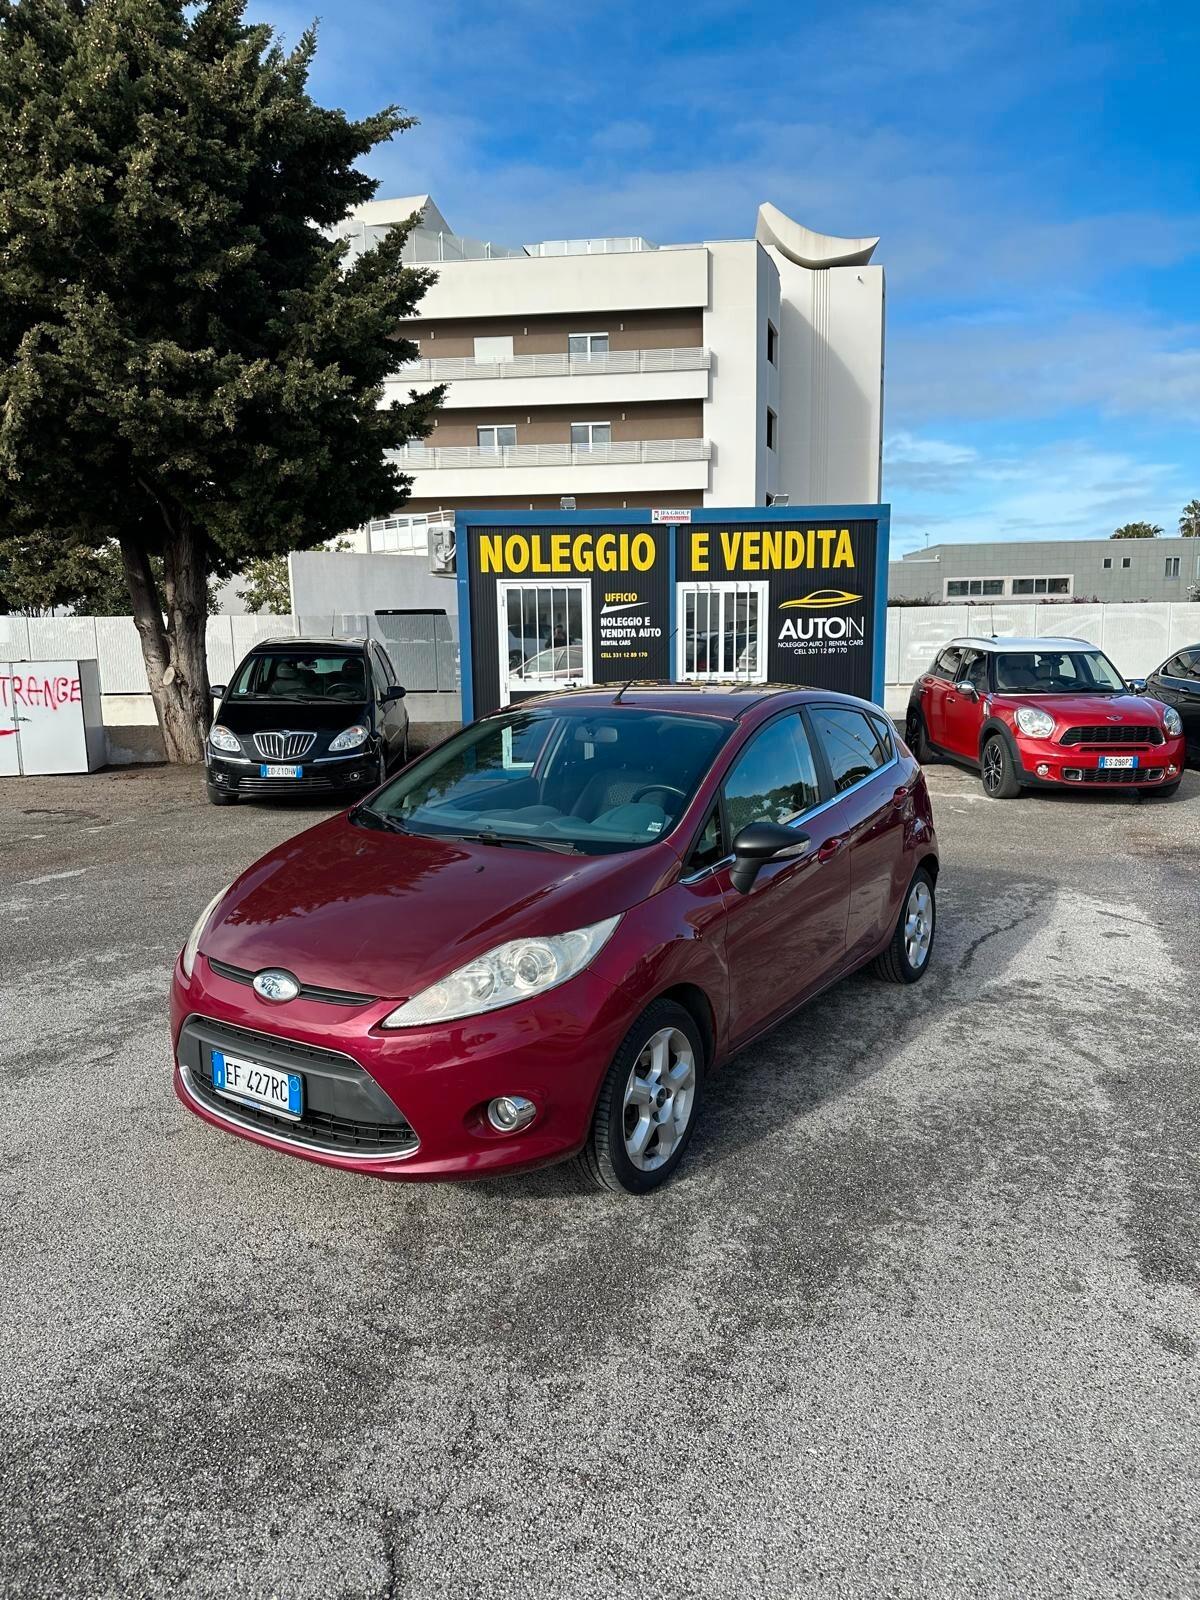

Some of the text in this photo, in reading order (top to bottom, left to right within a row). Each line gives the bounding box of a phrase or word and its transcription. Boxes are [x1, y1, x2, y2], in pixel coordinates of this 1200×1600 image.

[479, 532, 656, 573] NOLEGGIO
[691, 529, 855, 572] E VENDITA
[604, 592, 638, 602] UFFICIO
[600, 616, 651, 627] NOLEGGIO E
[778, 616, 864, 640] AUTOIN
[600, 627, 662, 638] VENDITA AUTO
